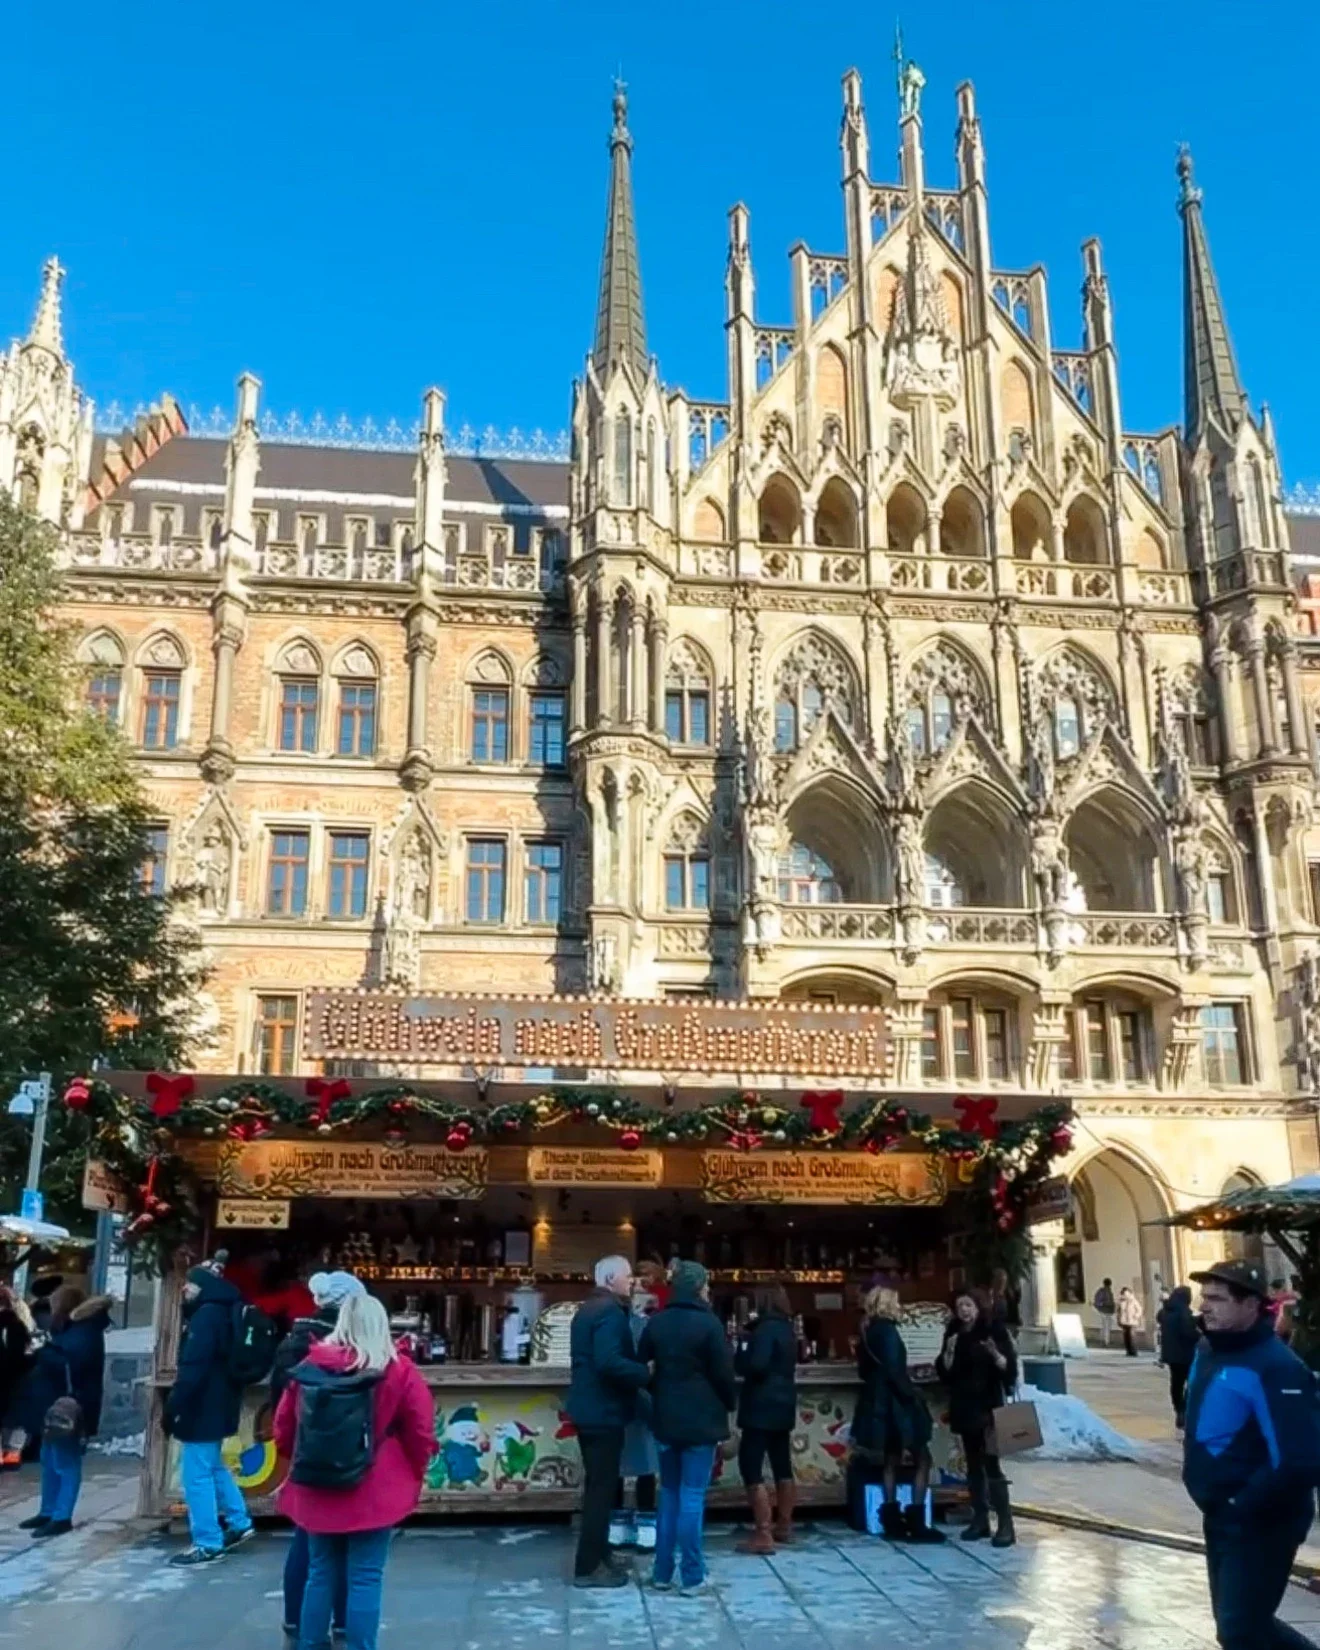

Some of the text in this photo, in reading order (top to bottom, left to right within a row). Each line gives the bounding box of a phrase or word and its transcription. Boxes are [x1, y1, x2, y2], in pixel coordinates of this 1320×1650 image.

[320, 998, 879, 1066] Glühwein nach Großmutterart
[338, 1149, 375, 1170] nach
[772, 1155, 805, 1177] nach
